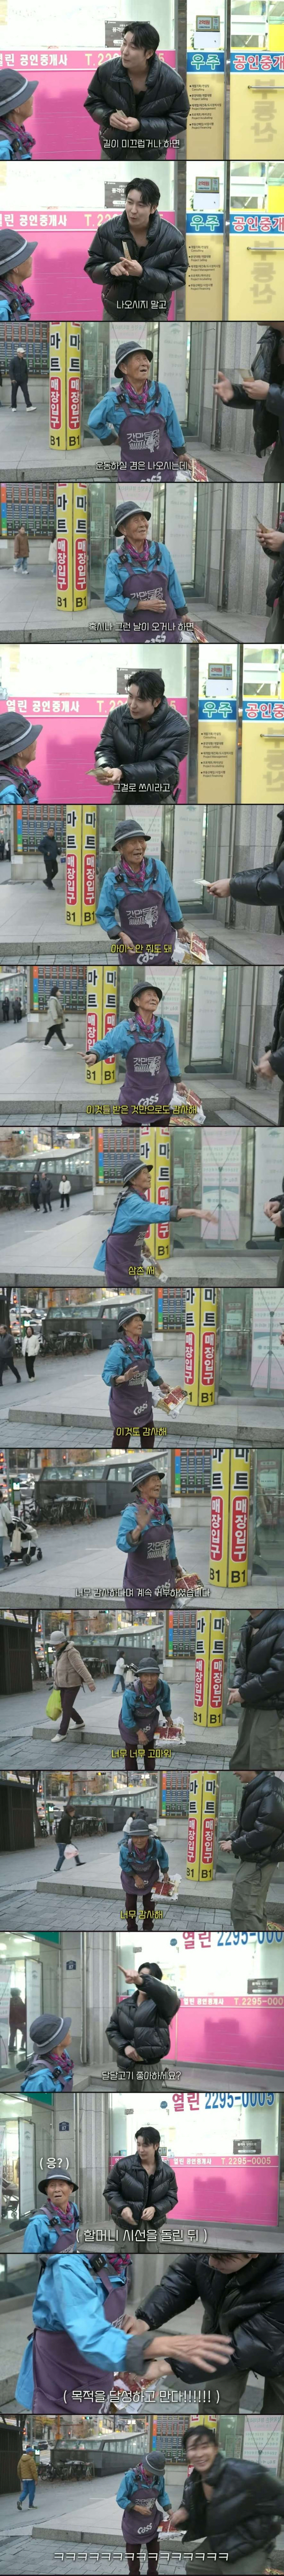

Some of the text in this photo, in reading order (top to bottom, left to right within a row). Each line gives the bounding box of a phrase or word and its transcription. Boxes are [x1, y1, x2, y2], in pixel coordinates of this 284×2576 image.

[20, 54, 68, 66] 공인중개사
[191, 54, 220, 70] 우주
[19, 215, 67, 226] 공인중개사
[190, 215, 220, 231] 우주
[51, 379, 60, 428] 매장입구
[71, 379, 80, 428] 매장입구
[50, 435, 60, 446] B1
[69, 435, 80, 446] B1
[58, 540, 67, 589] 매장입구
[77, 540, 86, 589] 매장입구
[57, 597, 67, 608] B1
[76, 596, 86, 607] B1
[6, 700, 80, 713] 열린 공인중개사
[203, 702, 232, 718] 우주
[67, 856, 75, 904] 매장입구
[86, 856, 95, 904] 매장입구
[66, 911, 76, 922] B1
[84, 911, 95, 922] B1
[87, 1070, 96, 1081] B1
[105, 1070, 115, 1081] B1
[158, 1246, 169, 1256] B1
[185, 1334, 193, 1383] 매장입구
[204, 1334, 214, 1383] 매장입구
[201, 1391, 213, 1402] B1
[211, 1499, 221, 1558] 매장입구
[234, 1499, 246, 1560] 매장입구
[210, 1568, 220, 1582] B1
[231, 1570, 245, 1583] B1
[213, 1660, 222, 1706] 매장입구
[194, 1712, 202, 1723] B1
[210, 1714, 221, 1723] B1
[204, 1820, 213, 1862] 매장입구
[186, 1868, 194, 1877] B1
[201, 1869, 211, 1878] B1
[183, 1932, 283, 1949] 열린 2295-000
[172, 2093, 275, 2112] 열린 2295-0005
